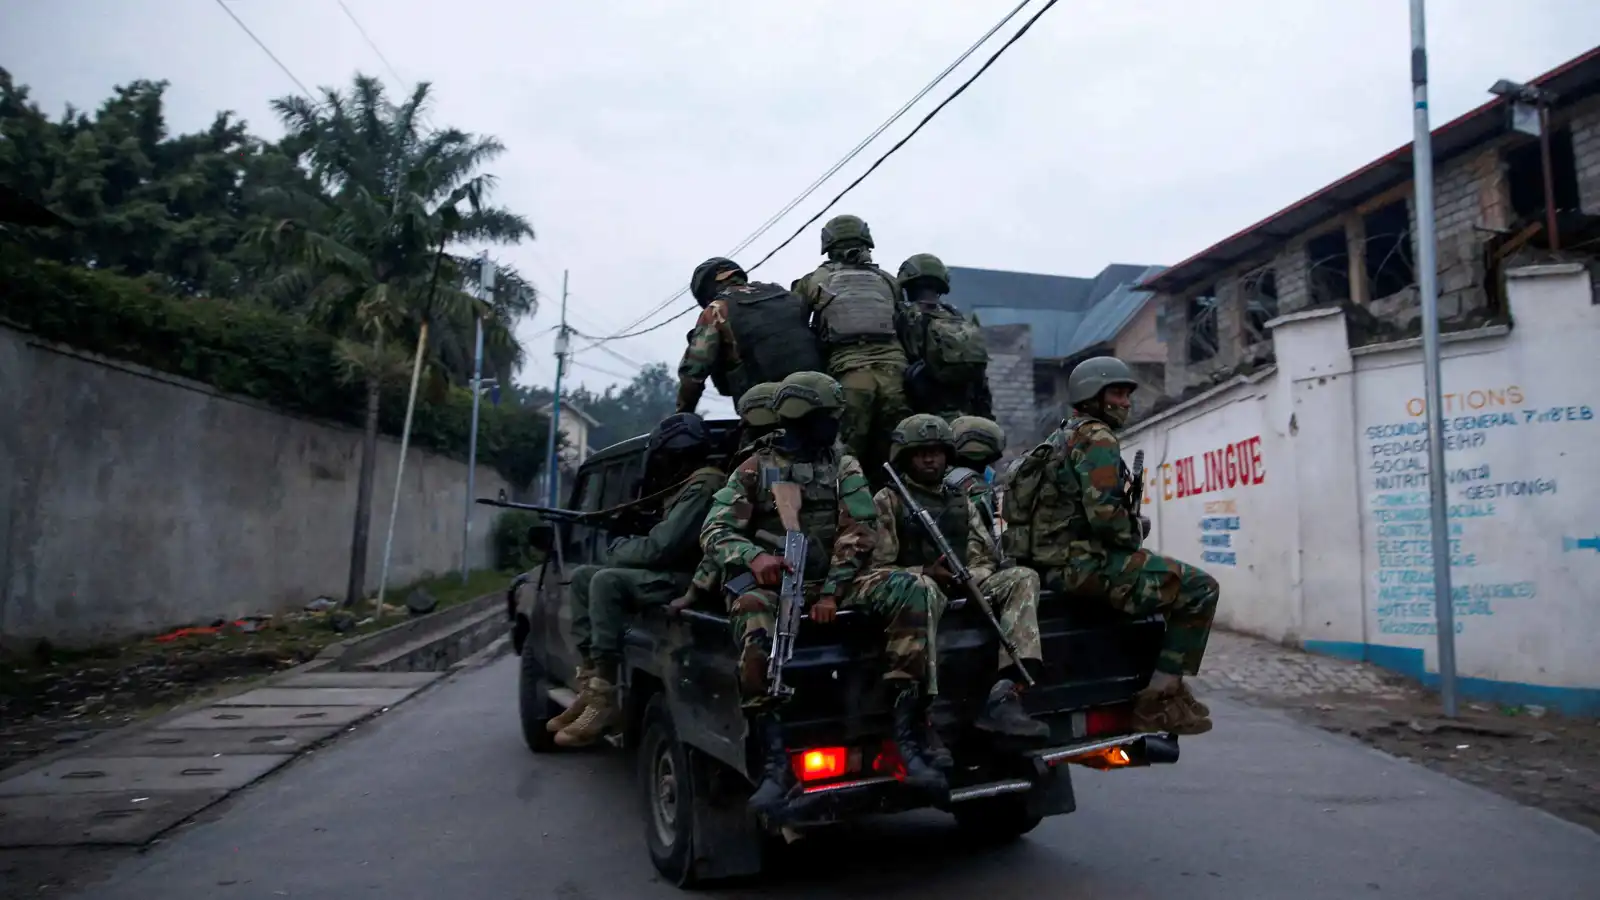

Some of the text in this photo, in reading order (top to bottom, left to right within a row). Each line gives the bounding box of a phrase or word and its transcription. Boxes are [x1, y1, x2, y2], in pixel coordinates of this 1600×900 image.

[1406, 385, 1525, 417] OTIONS
[1454, 410, 1518, 431] GENERAL
[1174, 435, 1266, 498] BILINGUE
